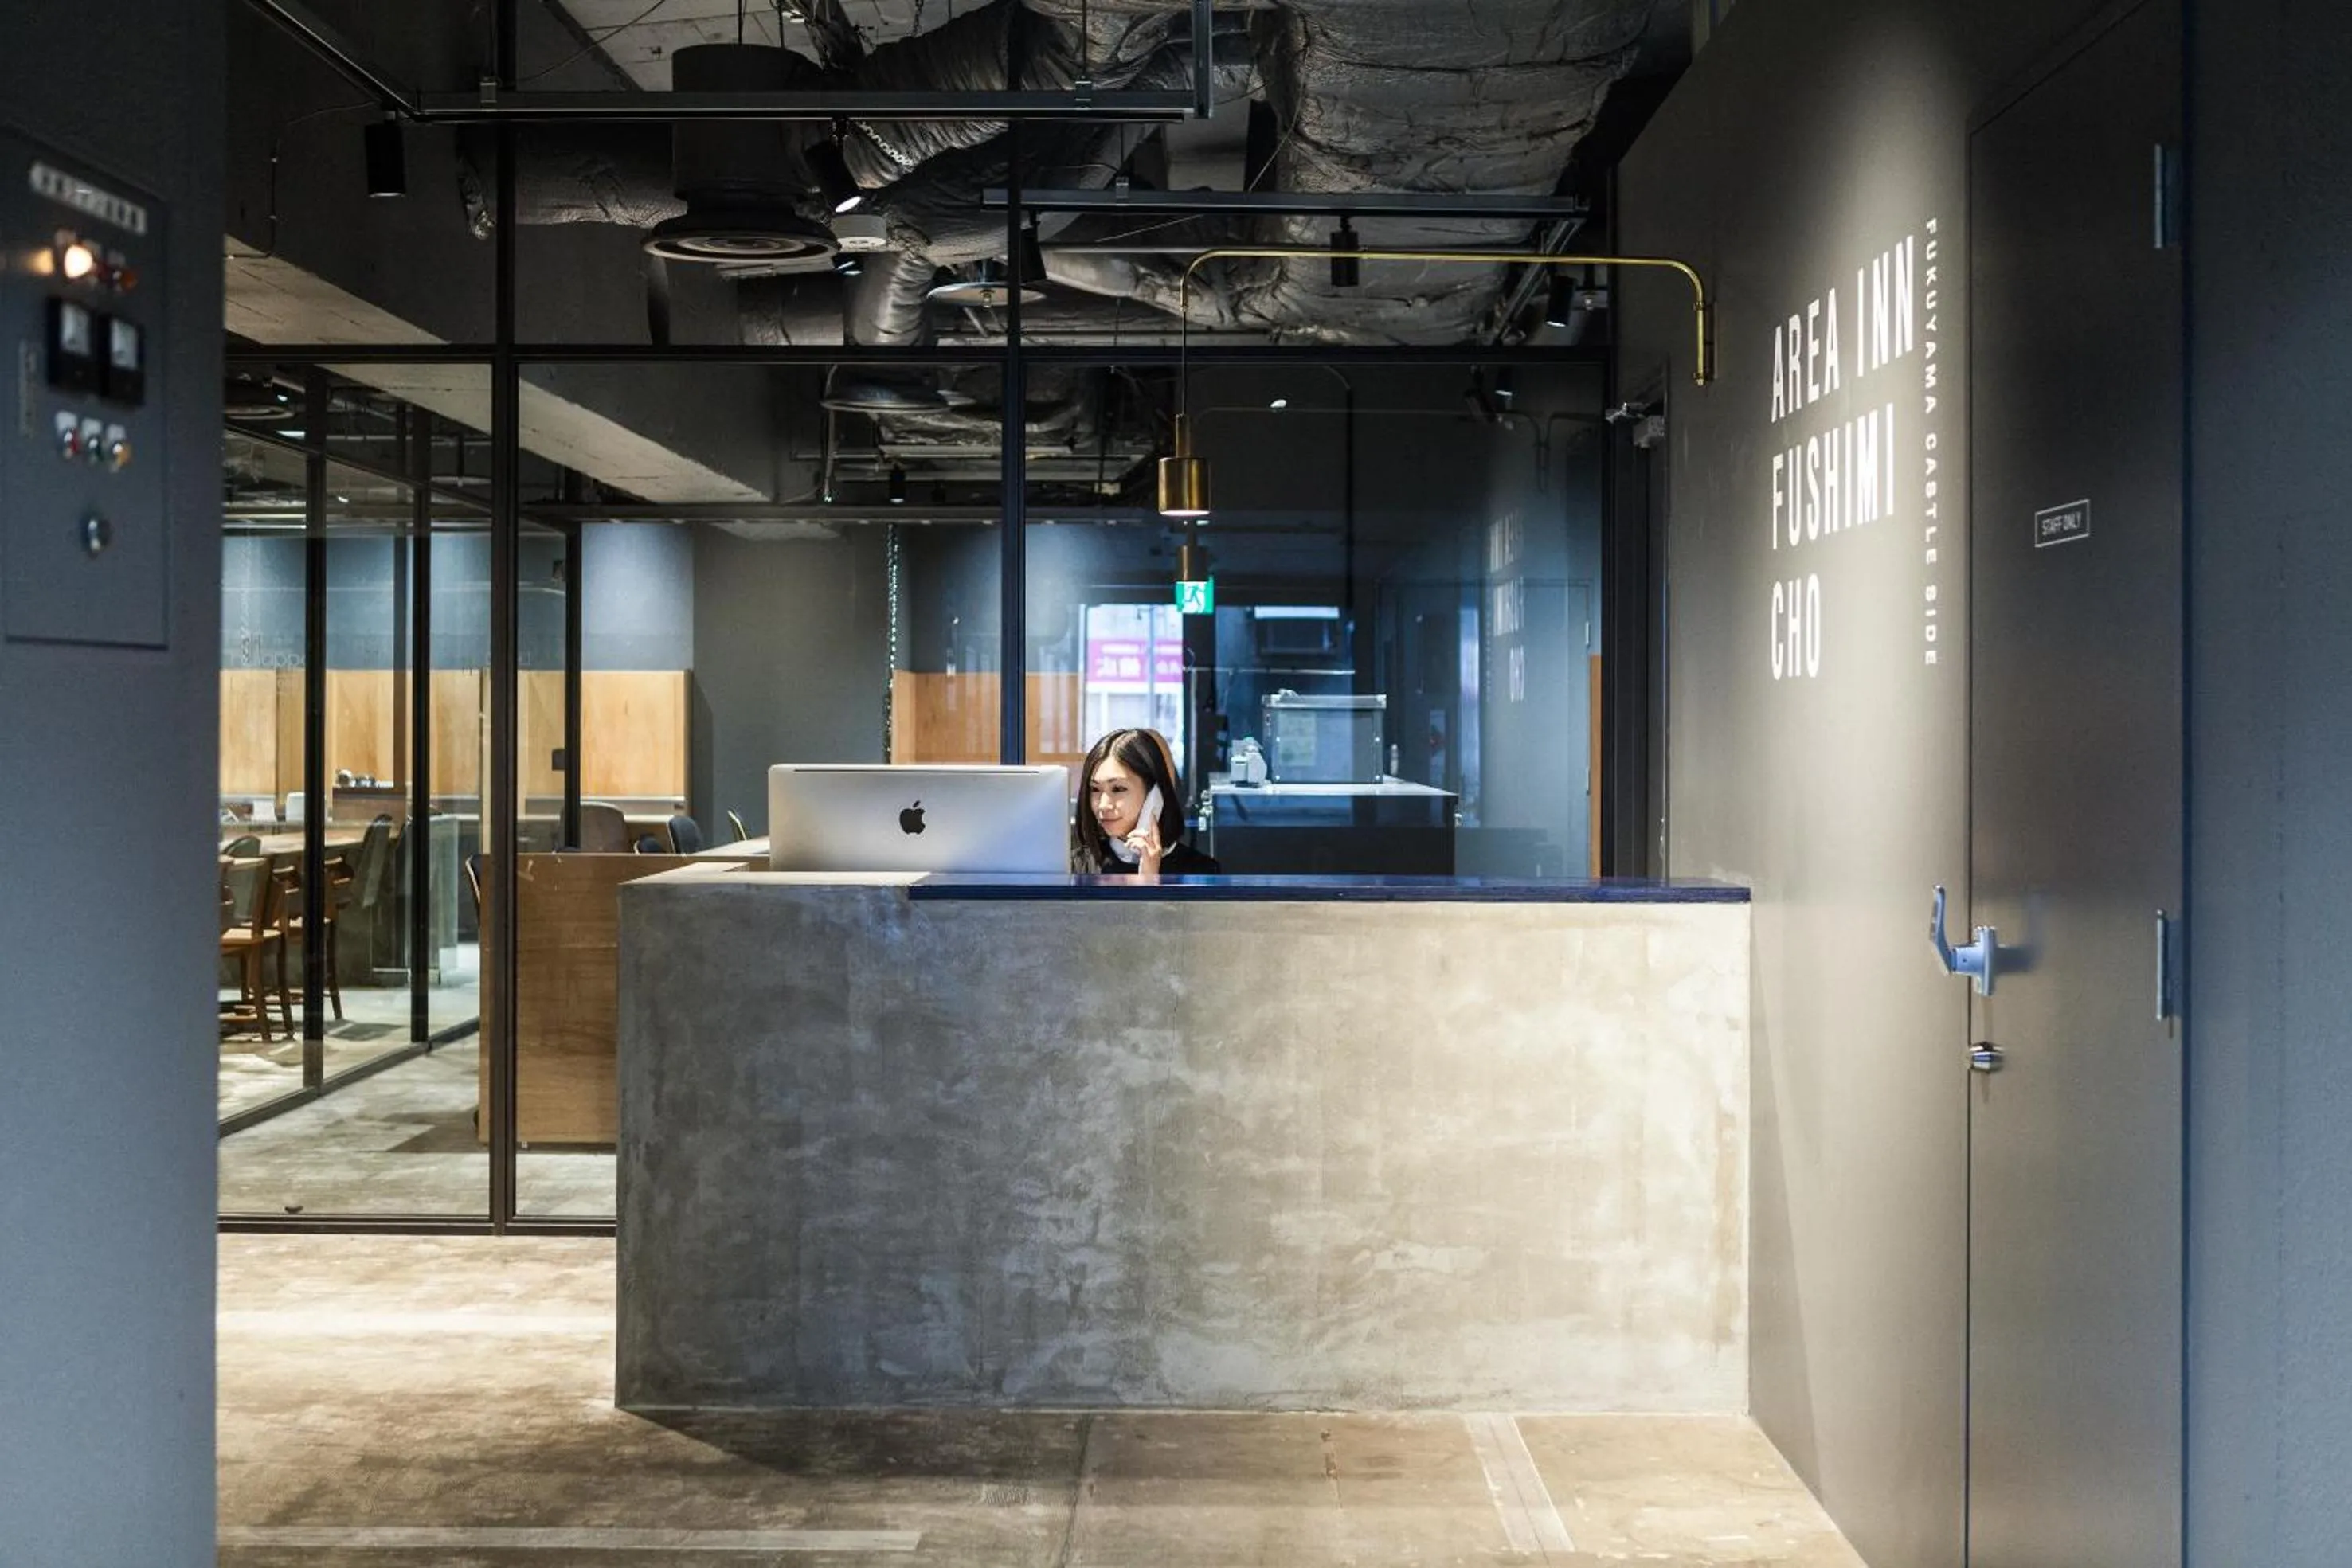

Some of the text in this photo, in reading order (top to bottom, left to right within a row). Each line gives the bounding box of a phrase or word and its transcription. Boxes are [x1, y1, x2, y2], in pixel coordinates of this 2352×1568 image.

[1771, 234, 1914, 423] AREA INN
[1772, 402, 1894, 550] FUSHIMI
[1925, 217, 1938, 665] FUKUYAMA CASTLE SIDE
[1771, 573, 1821, 681] CHO
